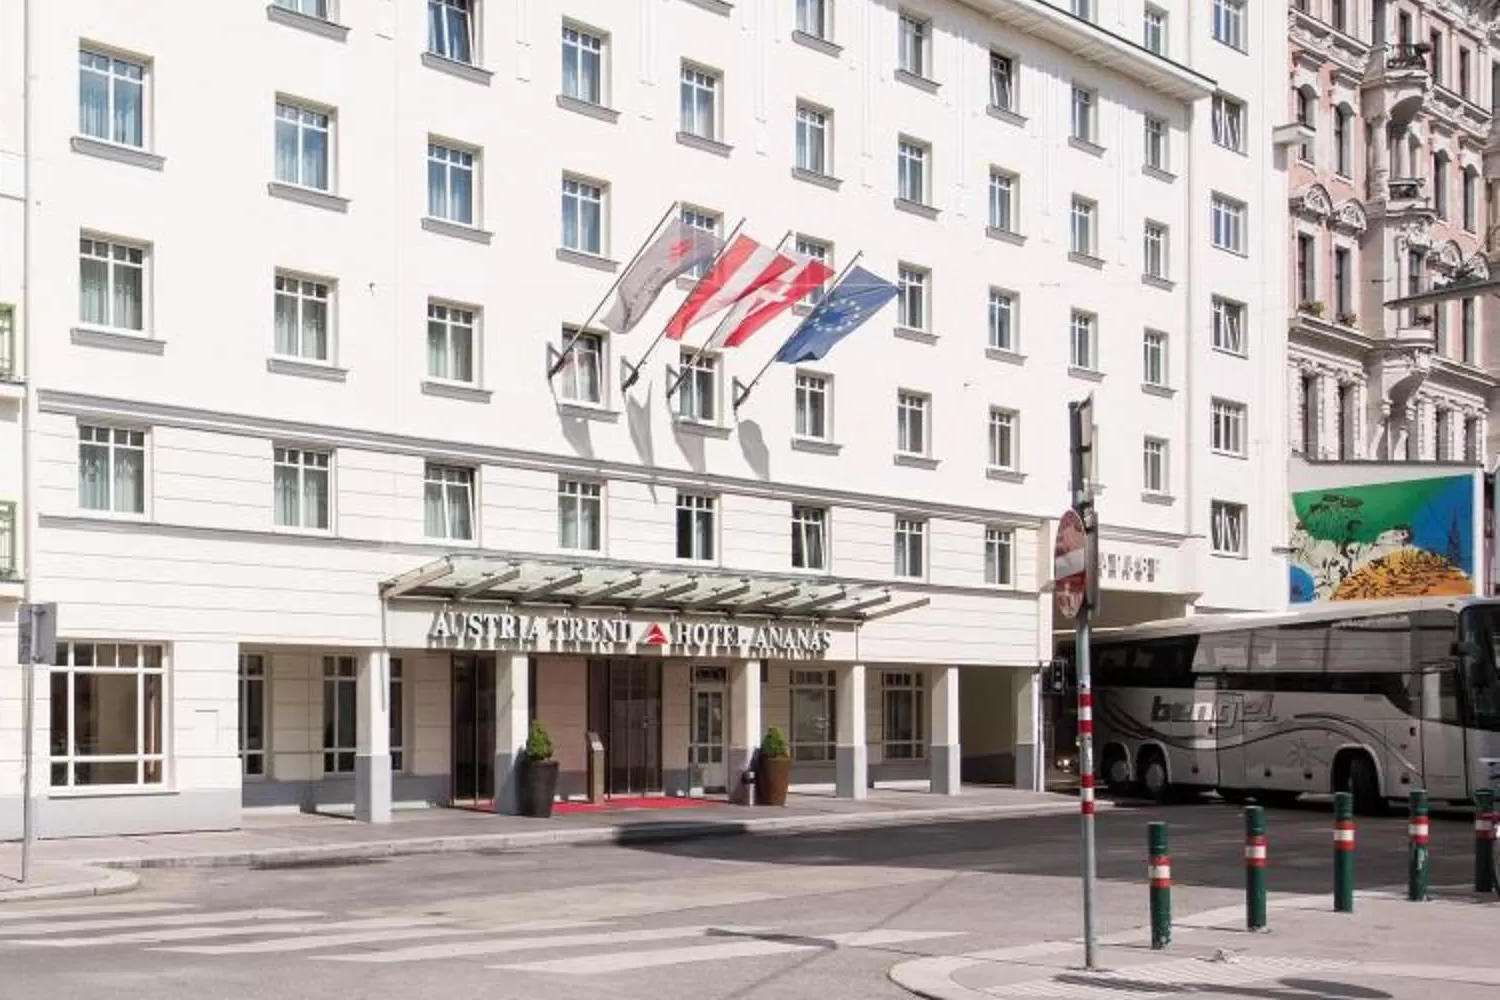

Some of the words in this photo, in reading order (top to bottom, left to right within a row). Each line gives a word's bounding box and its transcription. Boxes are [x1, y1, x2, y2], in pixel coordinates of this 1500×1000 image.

[433, 611, 545, 641] AUSTRIA
[553, 614, 634, 644] TREND
[676, 622, 749, 648] HOTEL
[754, 626, 833, 651] ANANAS
